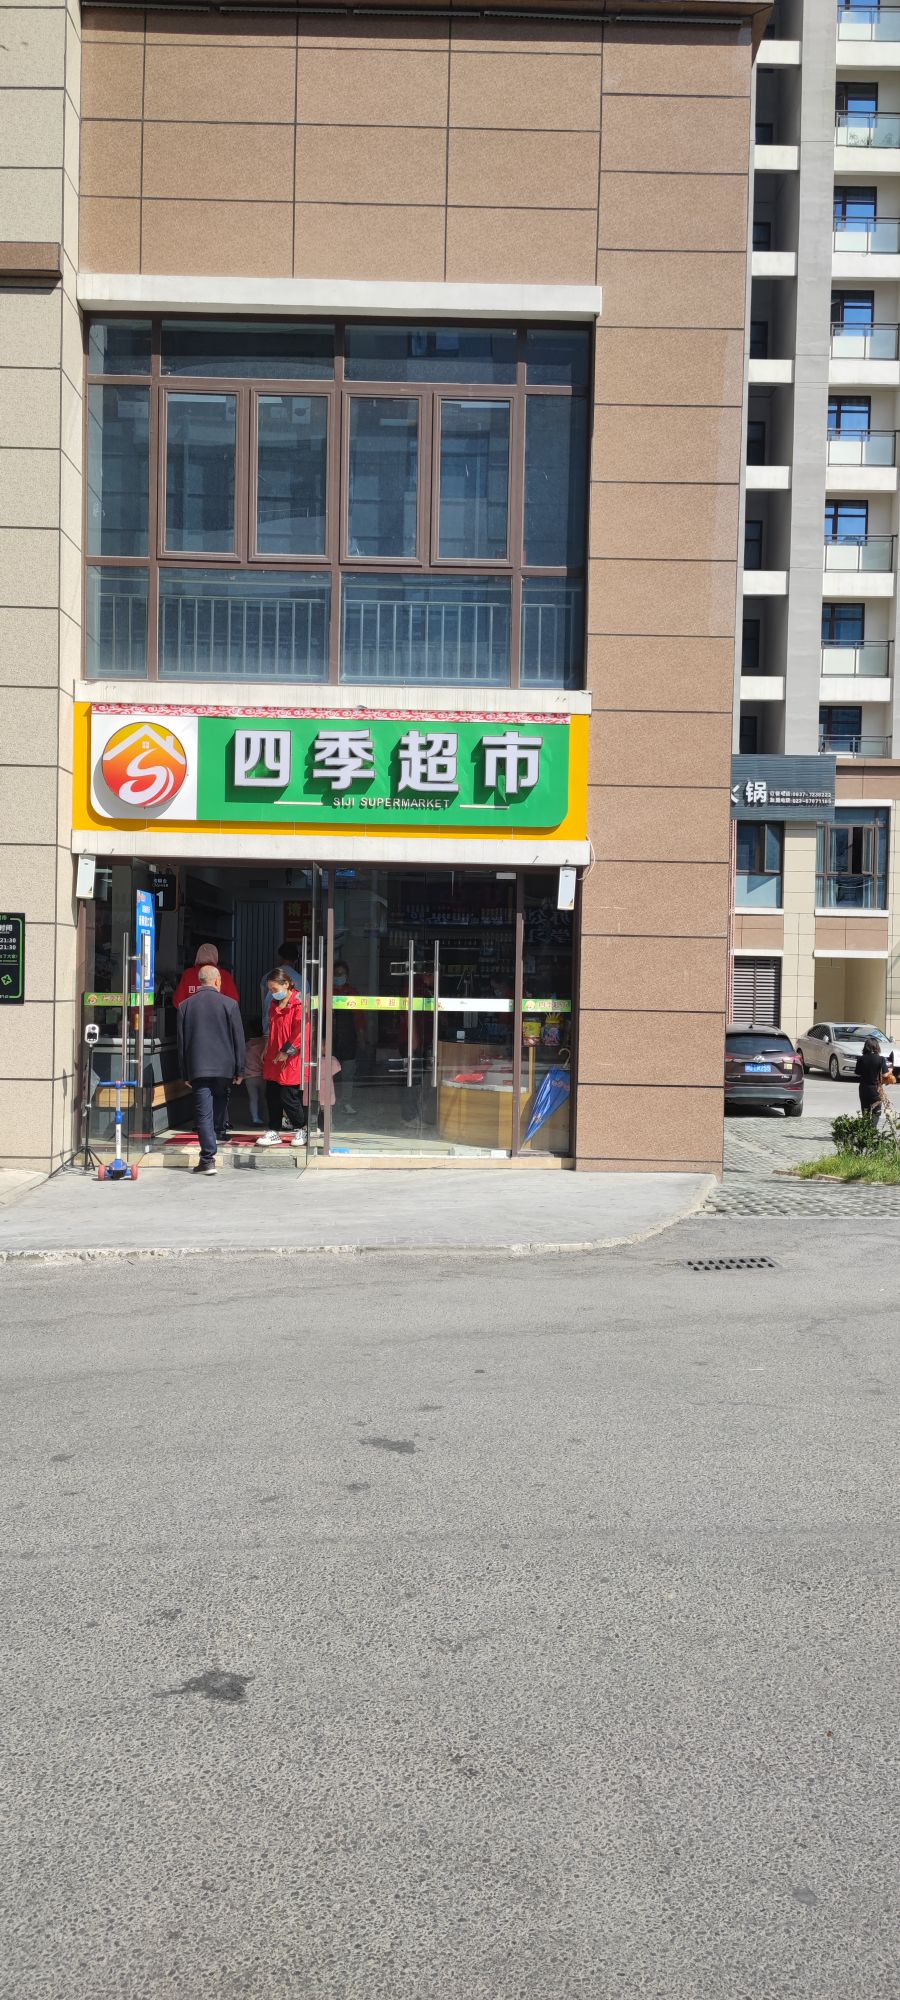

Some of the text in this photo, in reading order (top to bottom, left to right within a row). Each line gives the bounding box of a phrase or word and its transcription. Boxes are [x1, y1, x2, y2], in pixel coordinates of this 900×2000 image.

[233, 729, 543, 794] 四季超市
[333, 796, 450, 810] SIJI SUPERMARKET
[156, 890, 164, 907] 1
